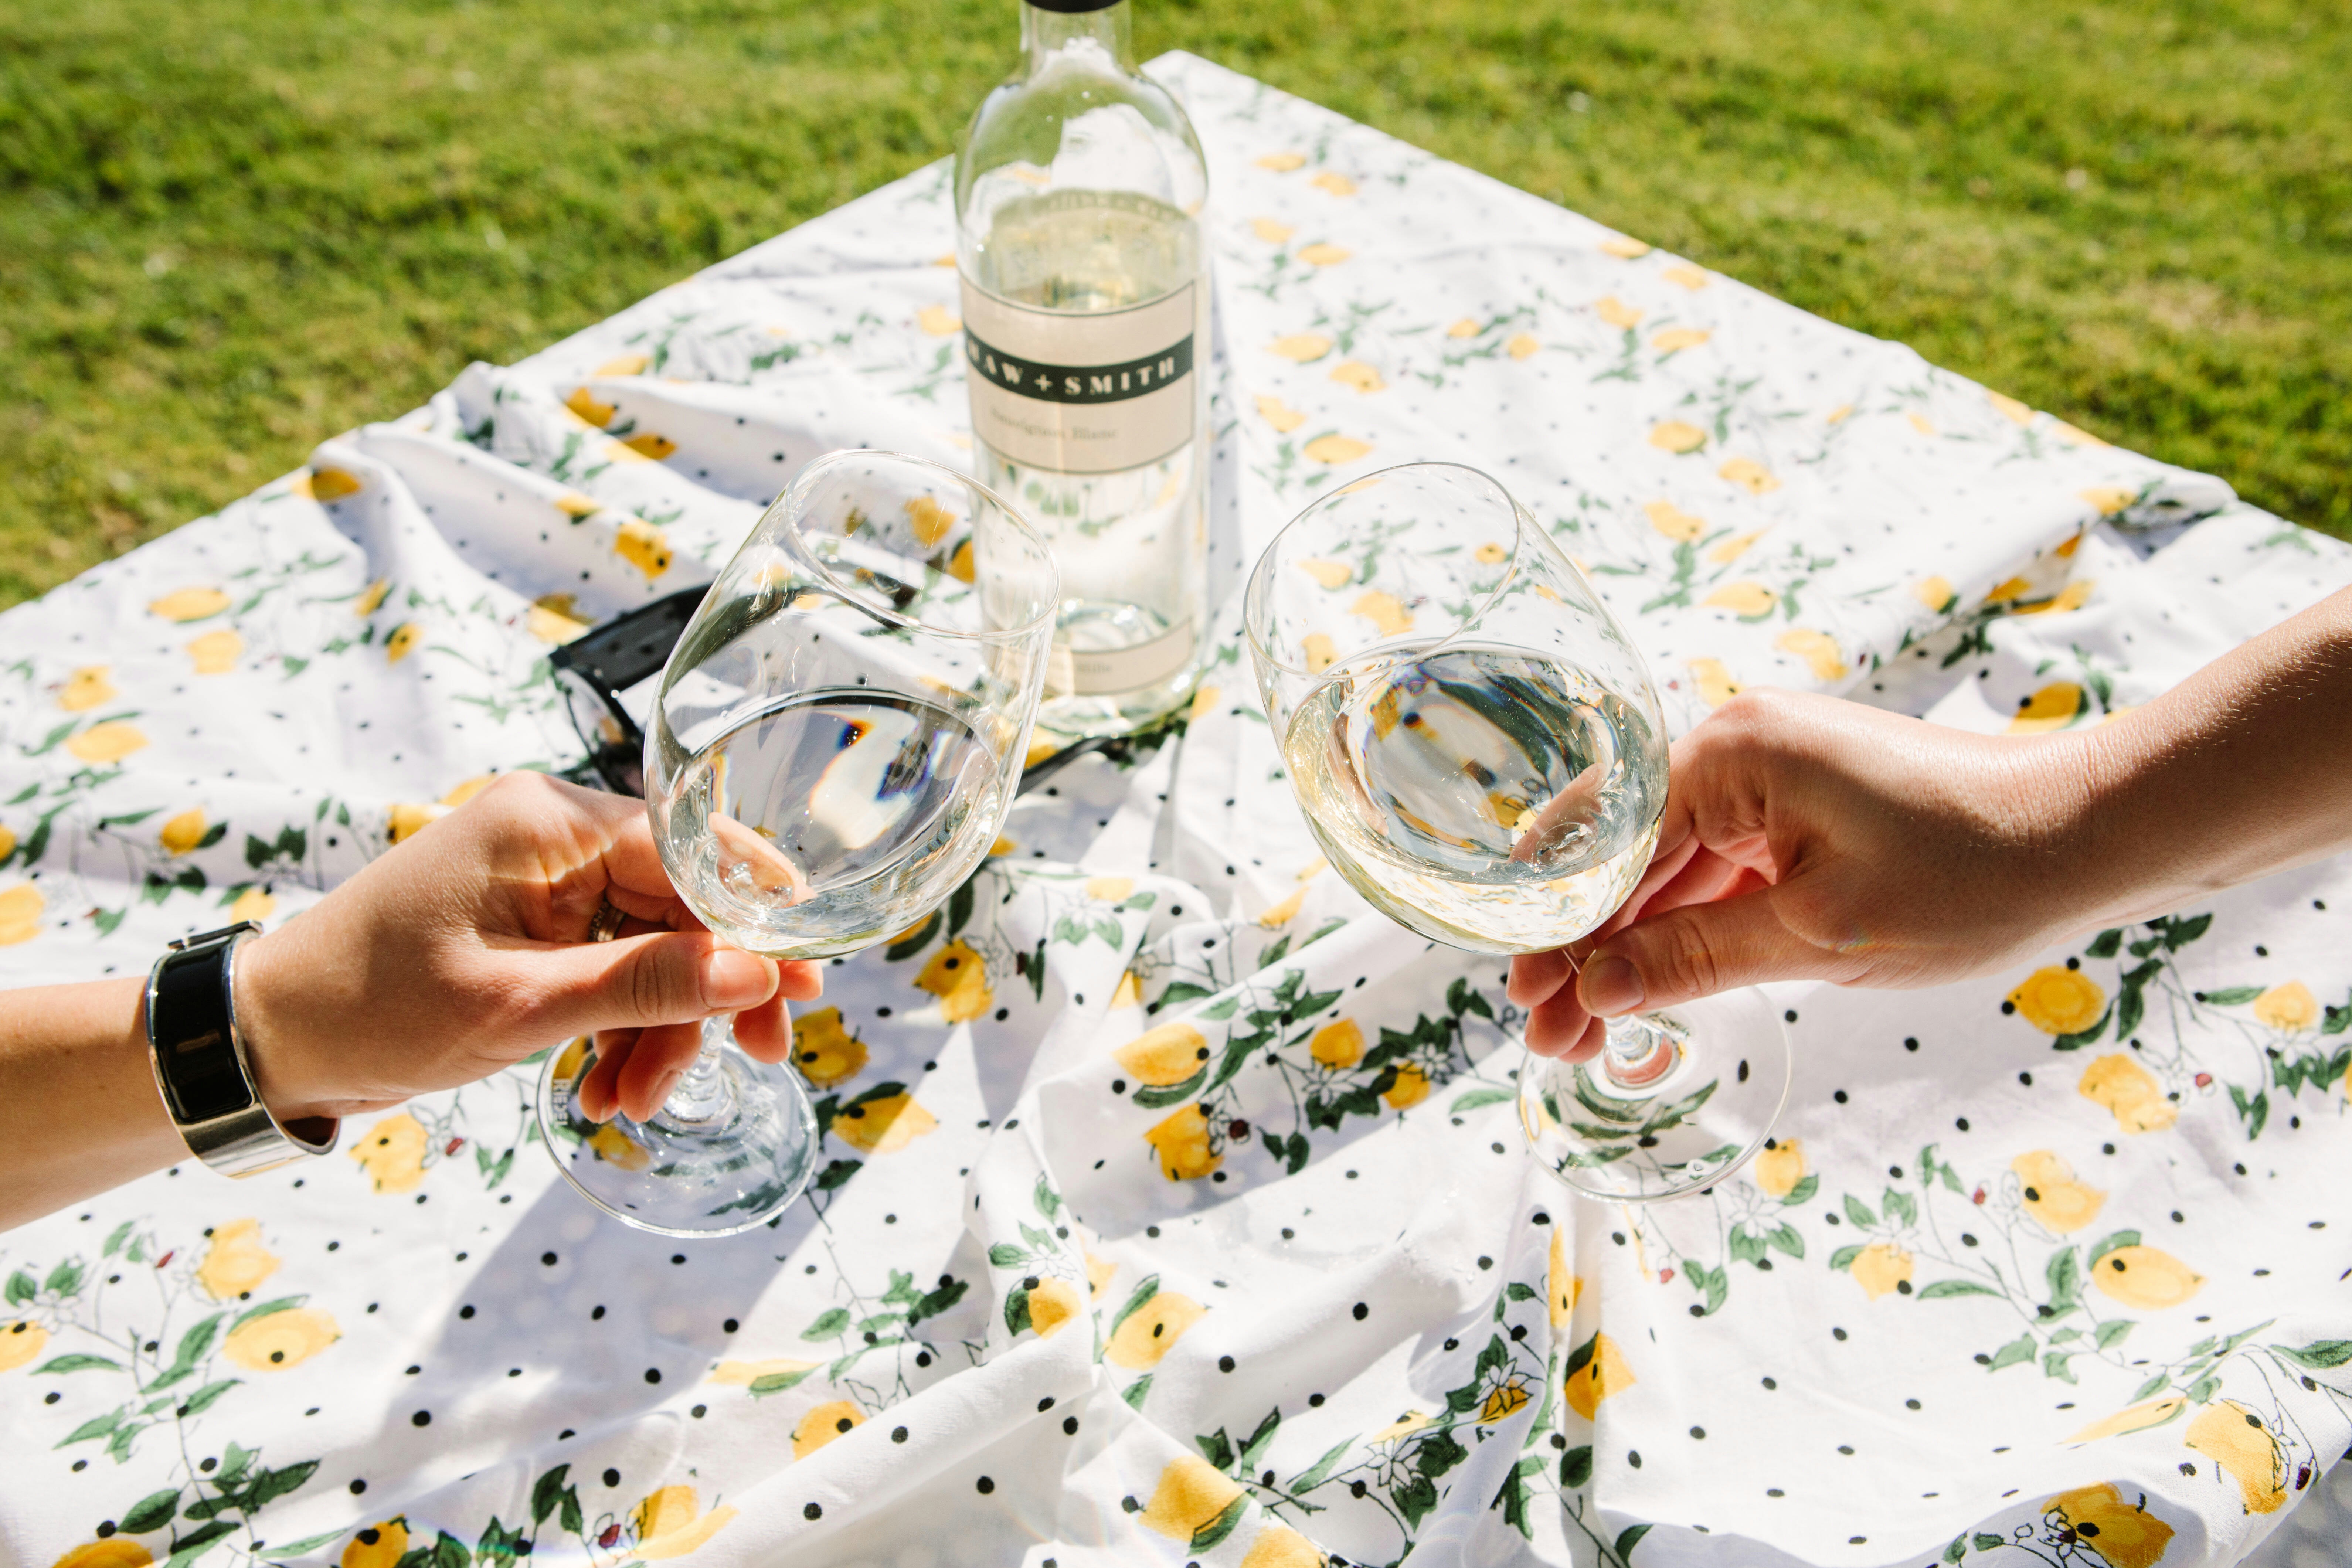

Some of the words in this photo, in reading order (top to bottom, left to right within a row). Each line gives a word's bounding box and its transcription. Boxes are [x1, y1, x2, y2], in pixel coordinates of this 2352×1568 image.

[1034, 374, 1053, 392] +
[1064, 356, 1175, 396] SMITH
[1073, 426, 1117, 440] Blanc
